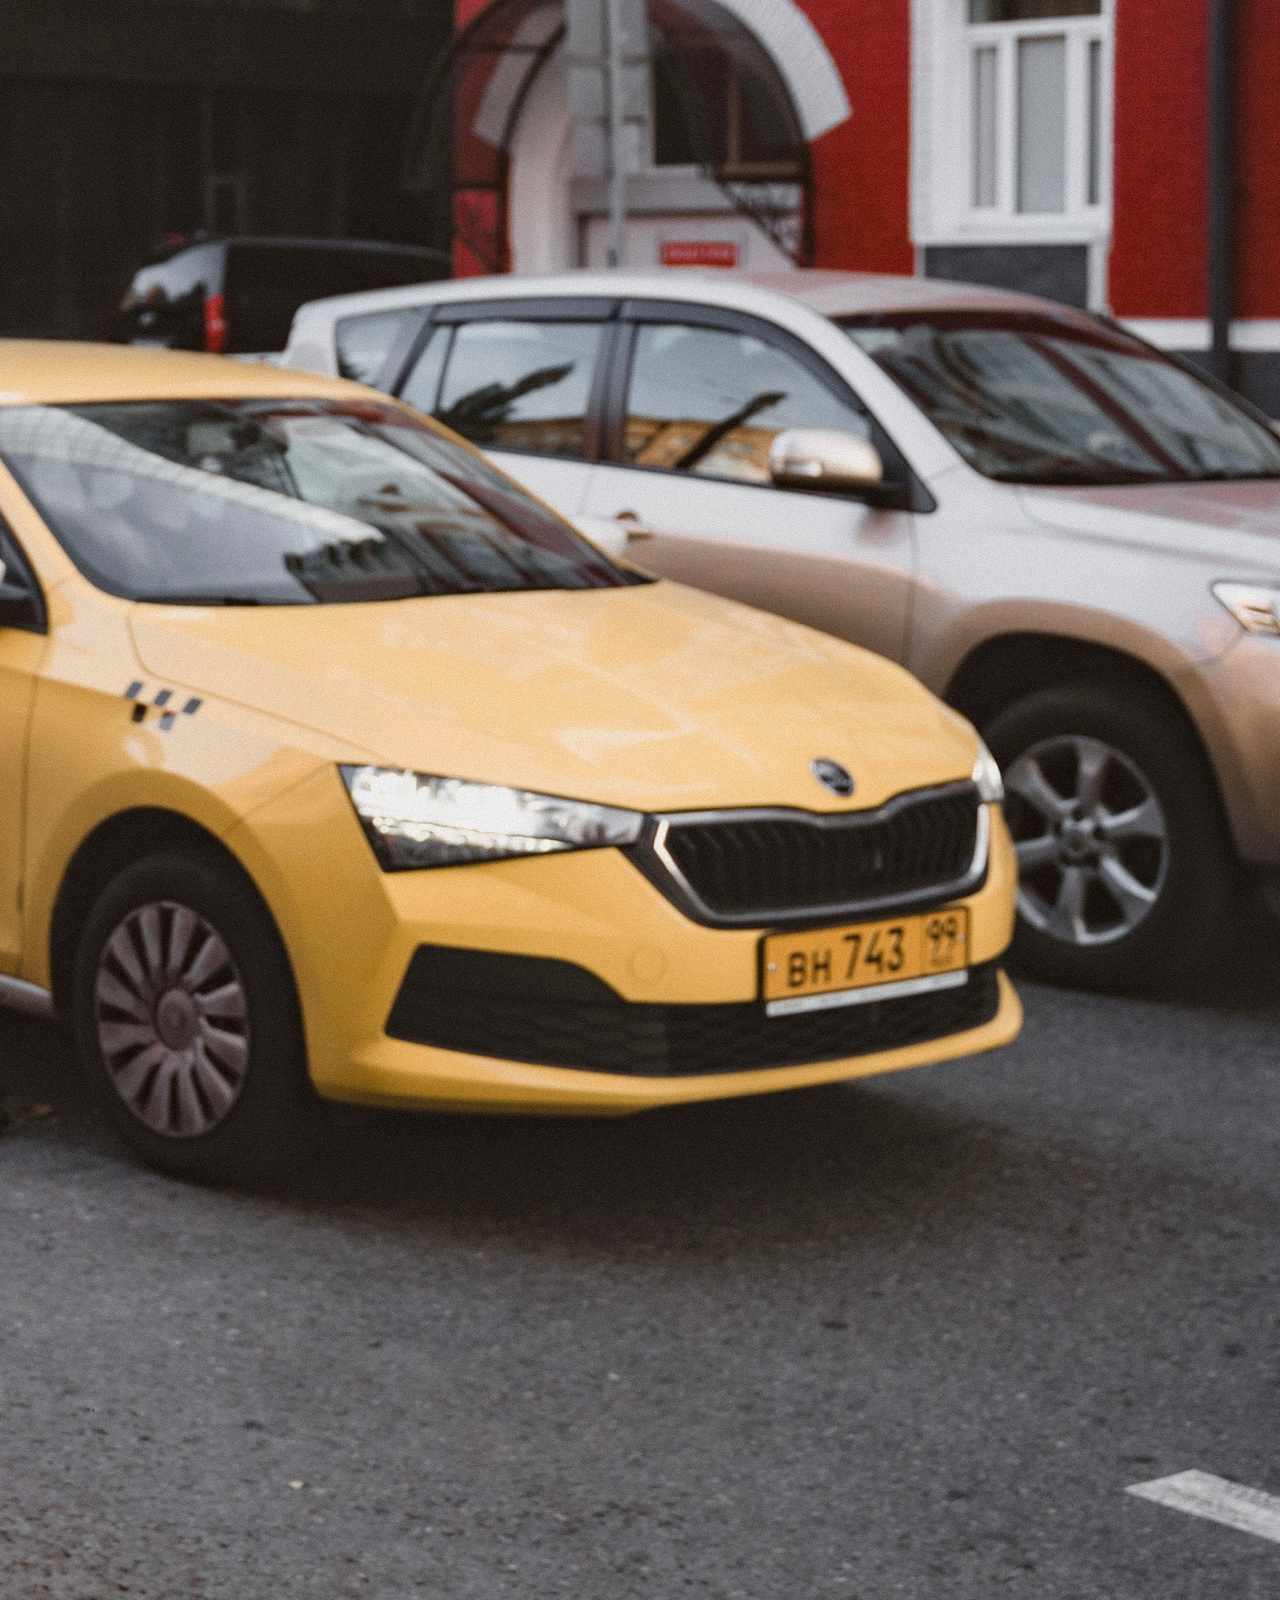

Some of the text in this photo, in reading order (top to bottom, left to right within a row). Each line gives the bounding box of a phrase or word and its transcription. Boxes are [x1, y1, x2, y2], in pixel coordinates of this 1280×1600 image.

[786, 915, 959, 988] ВН 743 99
